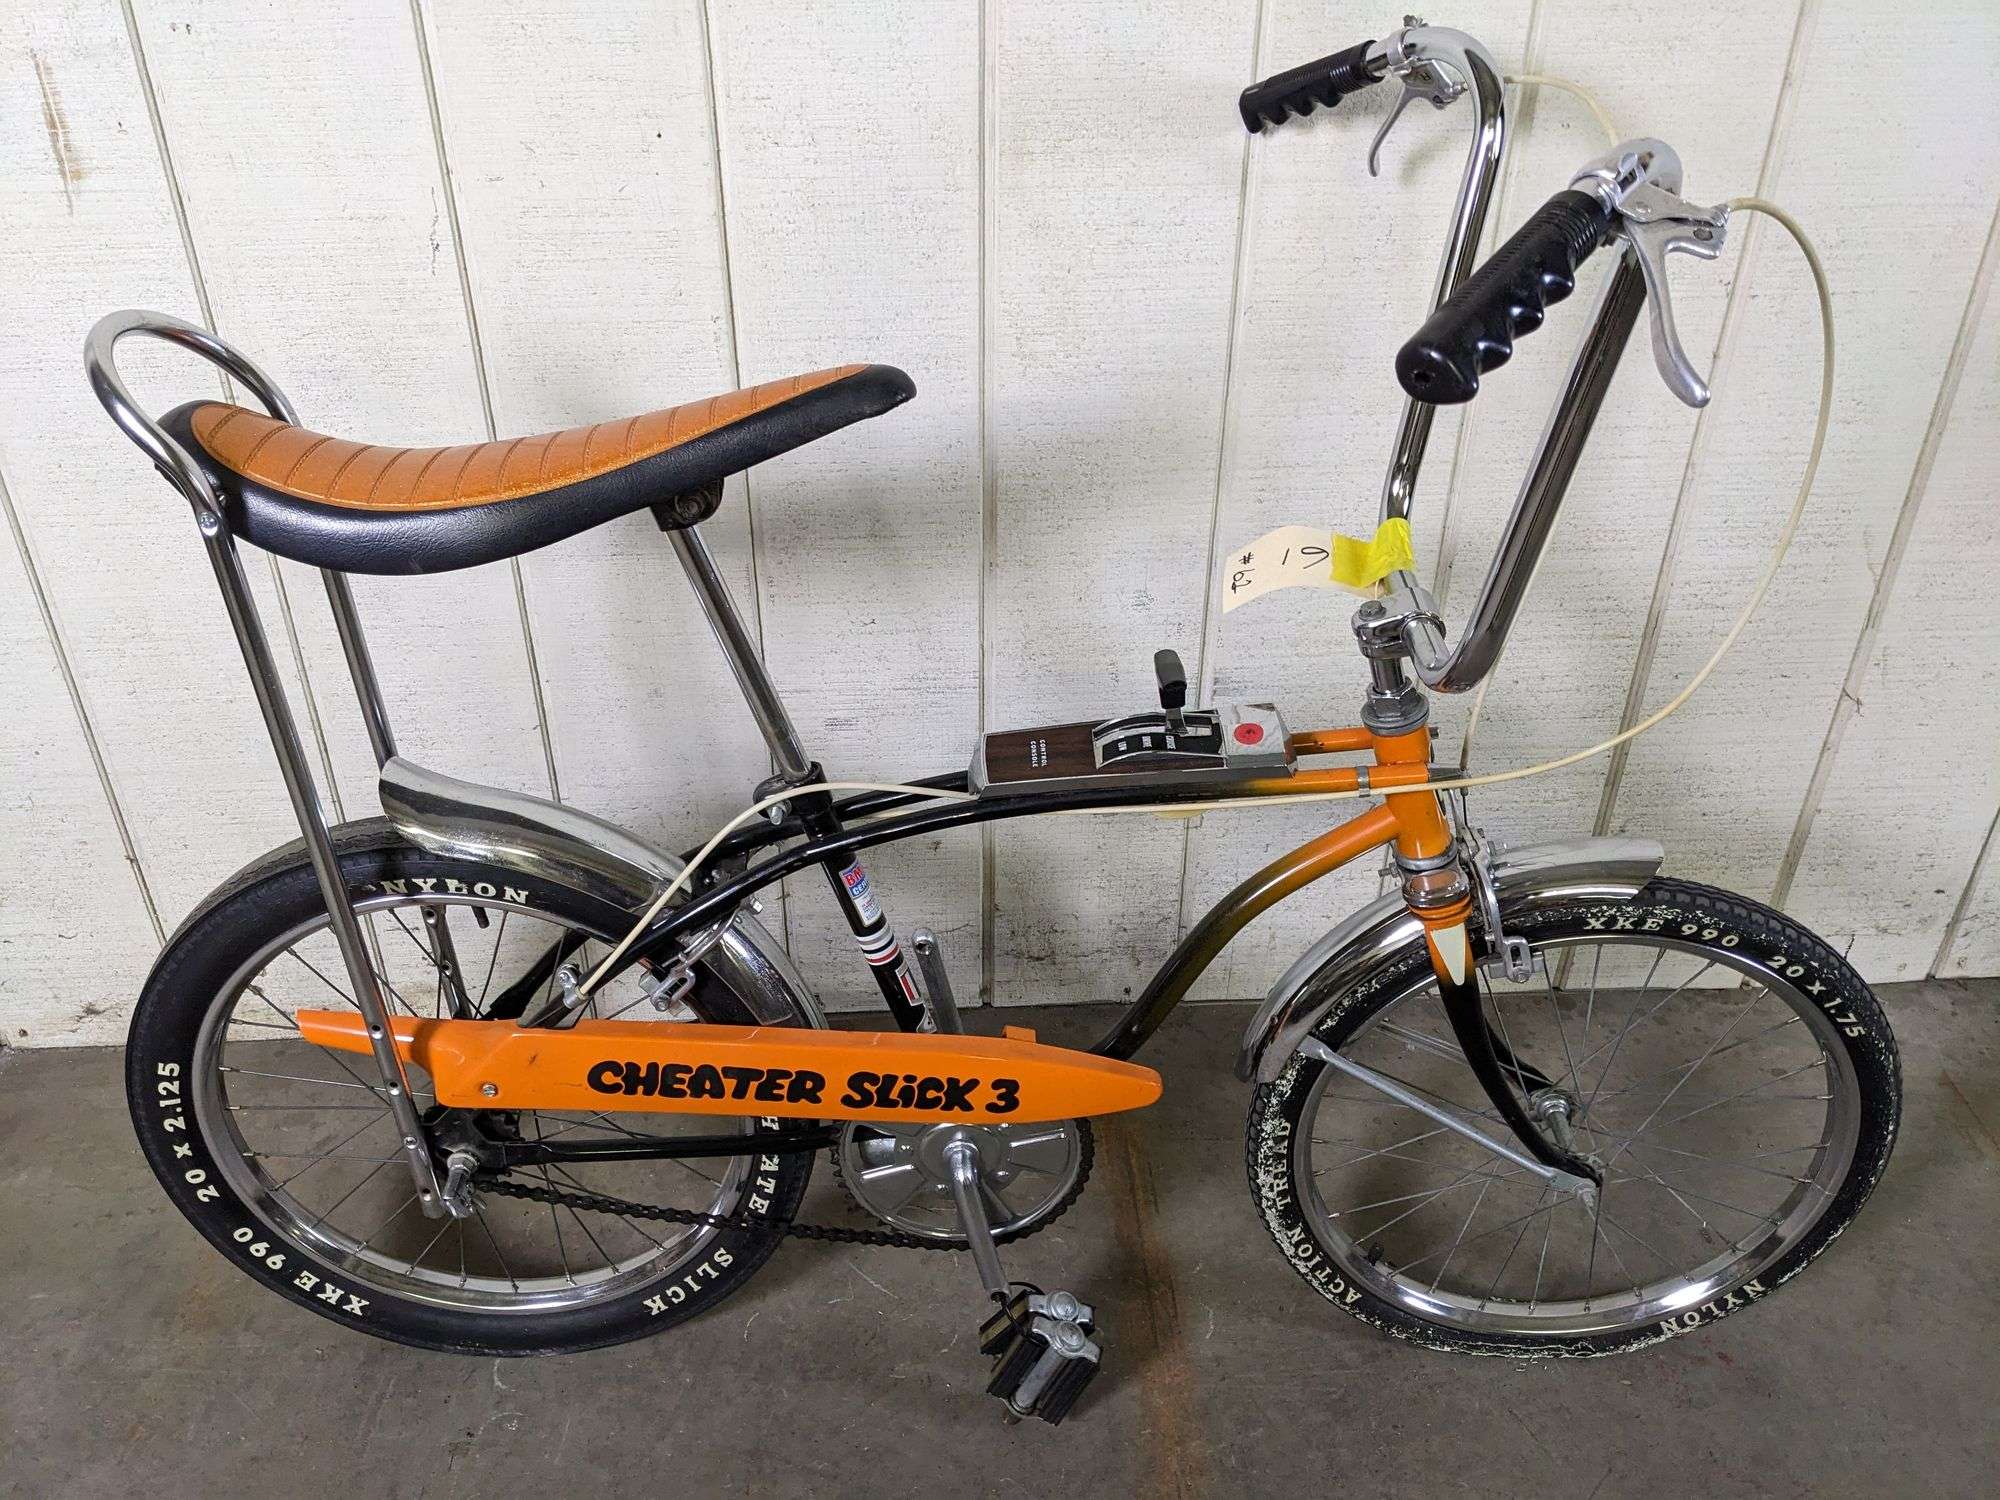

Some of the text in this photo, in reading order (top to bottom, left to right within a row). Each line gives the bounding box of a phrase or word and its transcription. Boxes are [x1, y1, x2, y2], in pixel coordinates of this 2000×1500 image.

[1030, 740, 1039, 768] CONSOLE
[380, 878, 529, 904] NYLON
[1583, 917, 1665, 931] XKE
[1680, 923, 1739, 947] 990
[1766, 955, 1805, 979] 20
[1823, 997, 1866, 1038] 1.75
[157, 1062, 186, 1132] 2.125
[586, 1060, 826, 1104] CHEATER
[984, 1078, 1021, 1114] 3
[185, 1168, 220, 1202] 20
[233, 1227, 287, 1271] 990
[1287, 1222, 1362, 1304] ACTION
[293, 1270, 370, 1316] XKE
[643, 1247, 734, 1315] SLICK
[1660, 1279, 1766, 1338] NYLON
